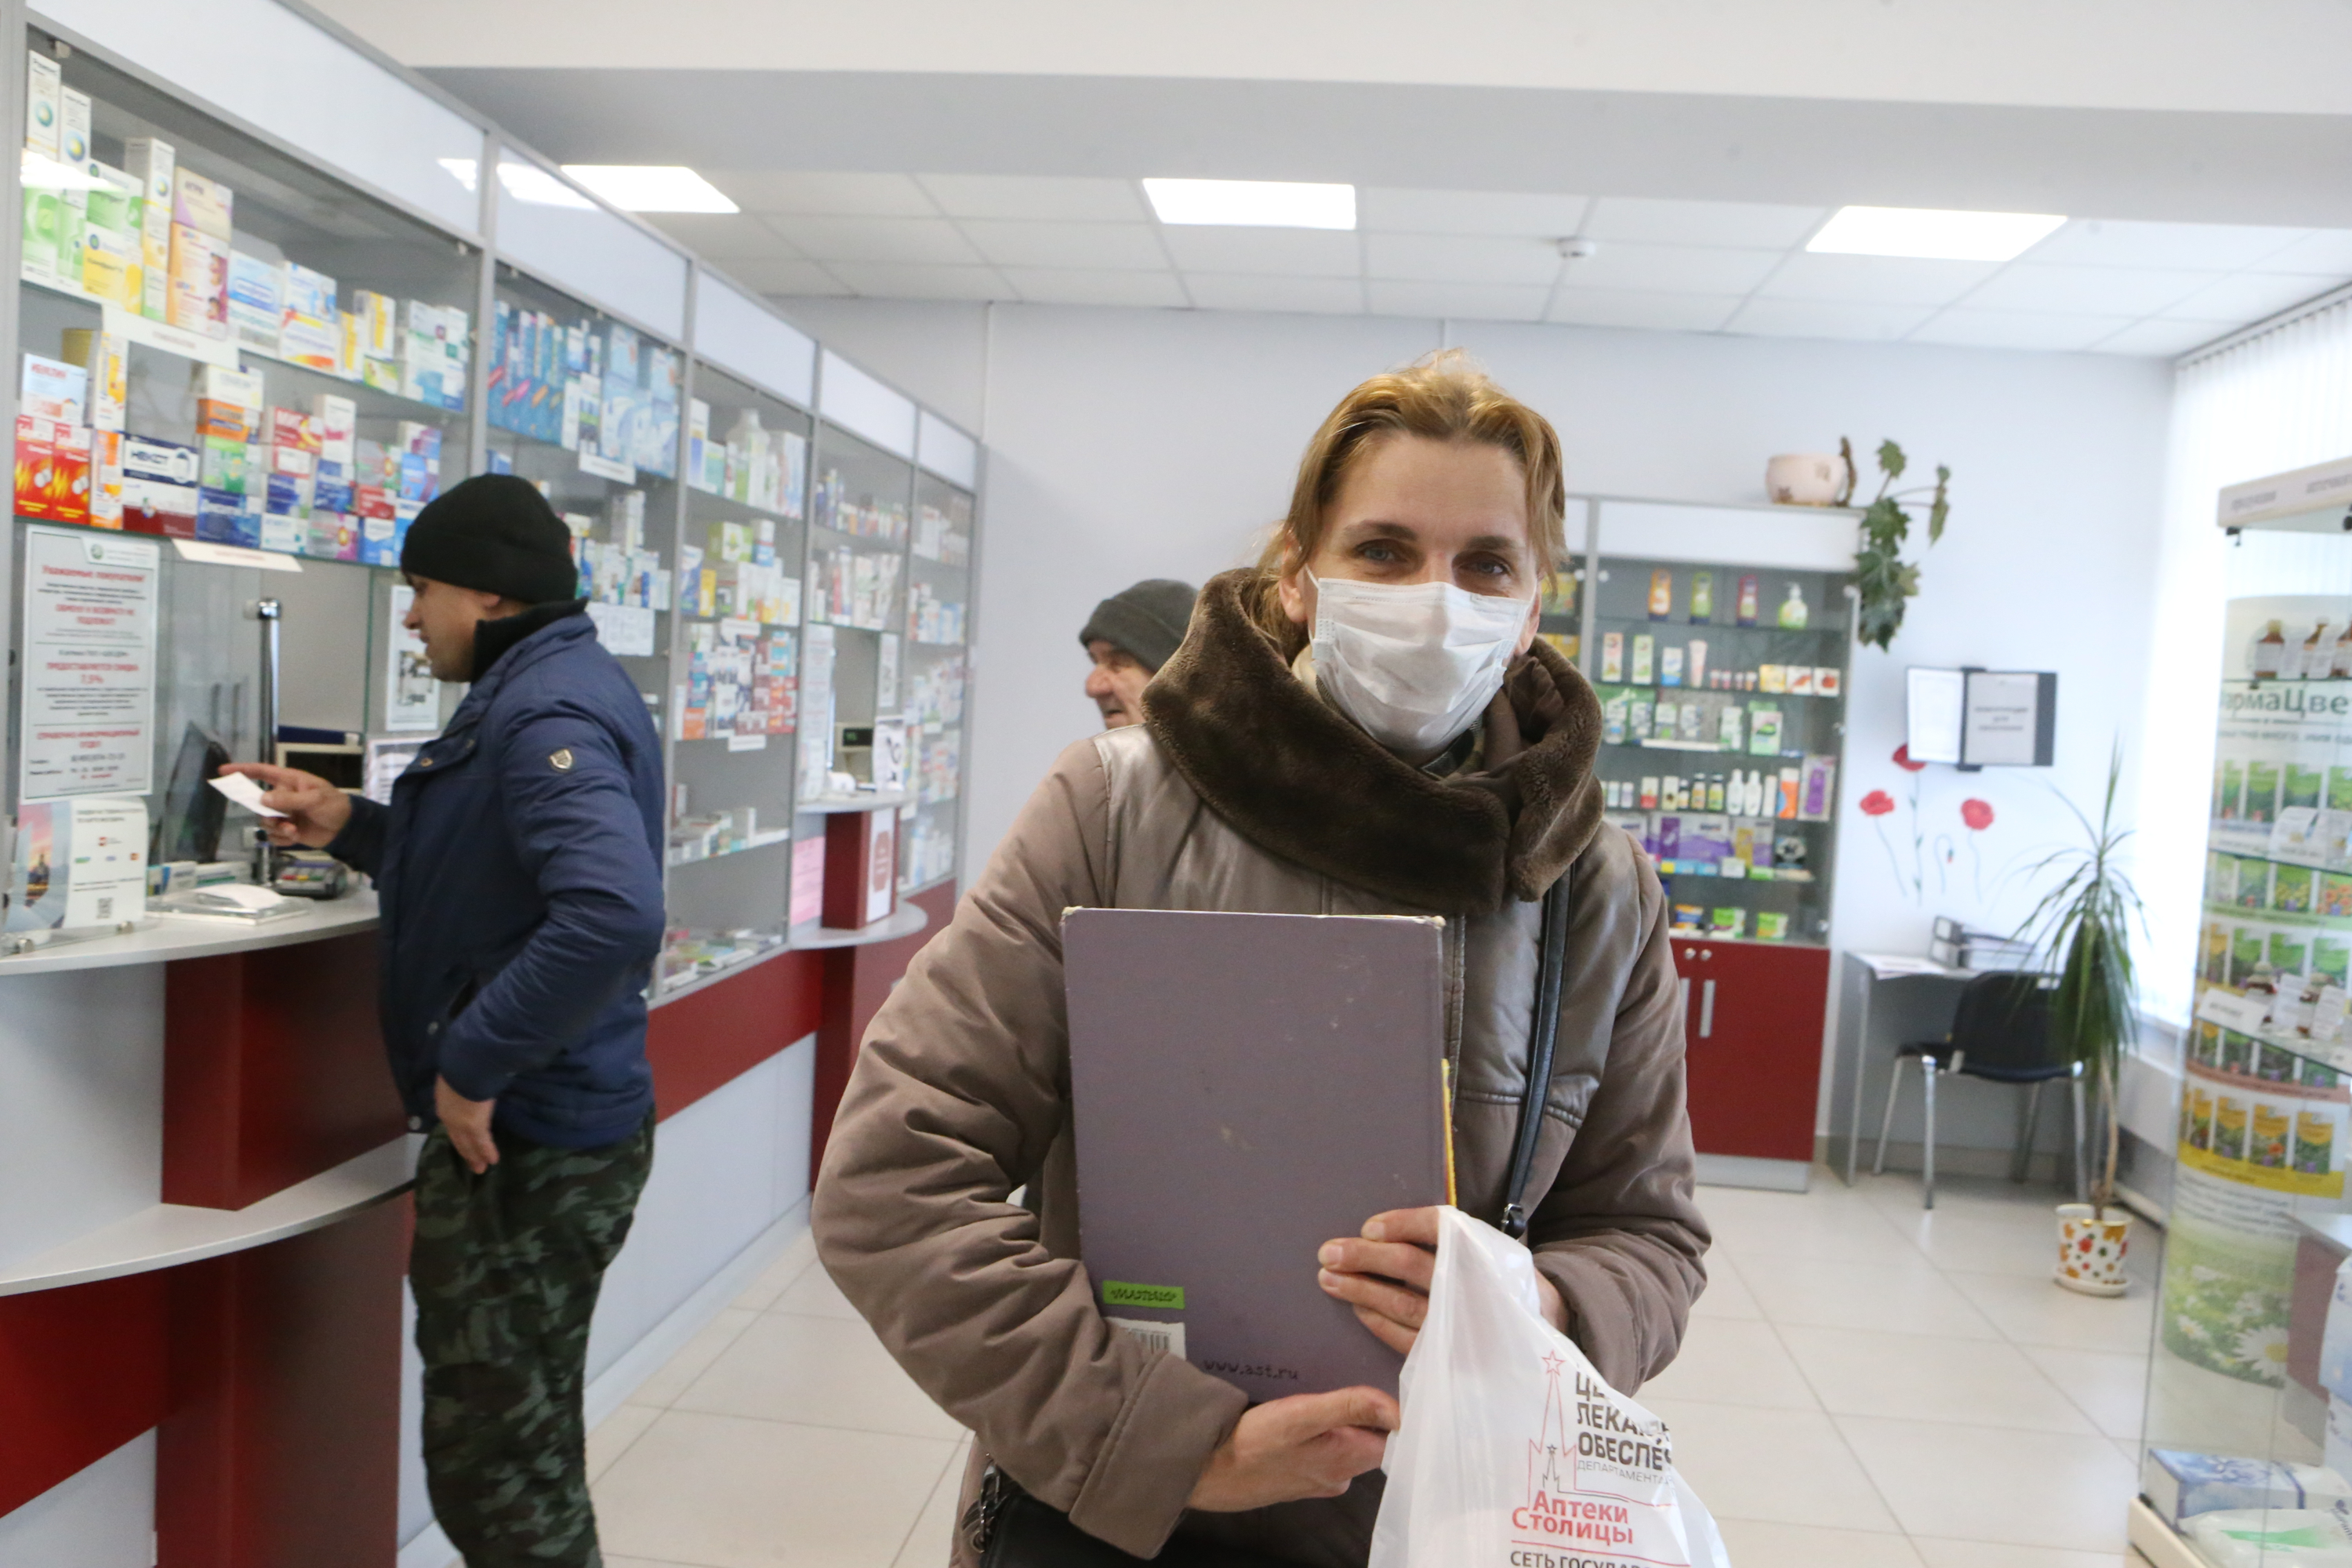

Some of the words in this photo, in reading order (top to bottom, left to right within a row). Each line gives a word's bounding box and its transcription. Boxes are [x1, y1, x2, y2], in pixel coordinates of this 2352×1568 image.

[1577, 1402, 1644, 1436] ЛЕКА
[1533, 1490, 1628, 1524] Аптеки
[1512, 1507, 1633, 1546] Столицы
[1510, 1551, 1555, 1568] СЕТЬ
